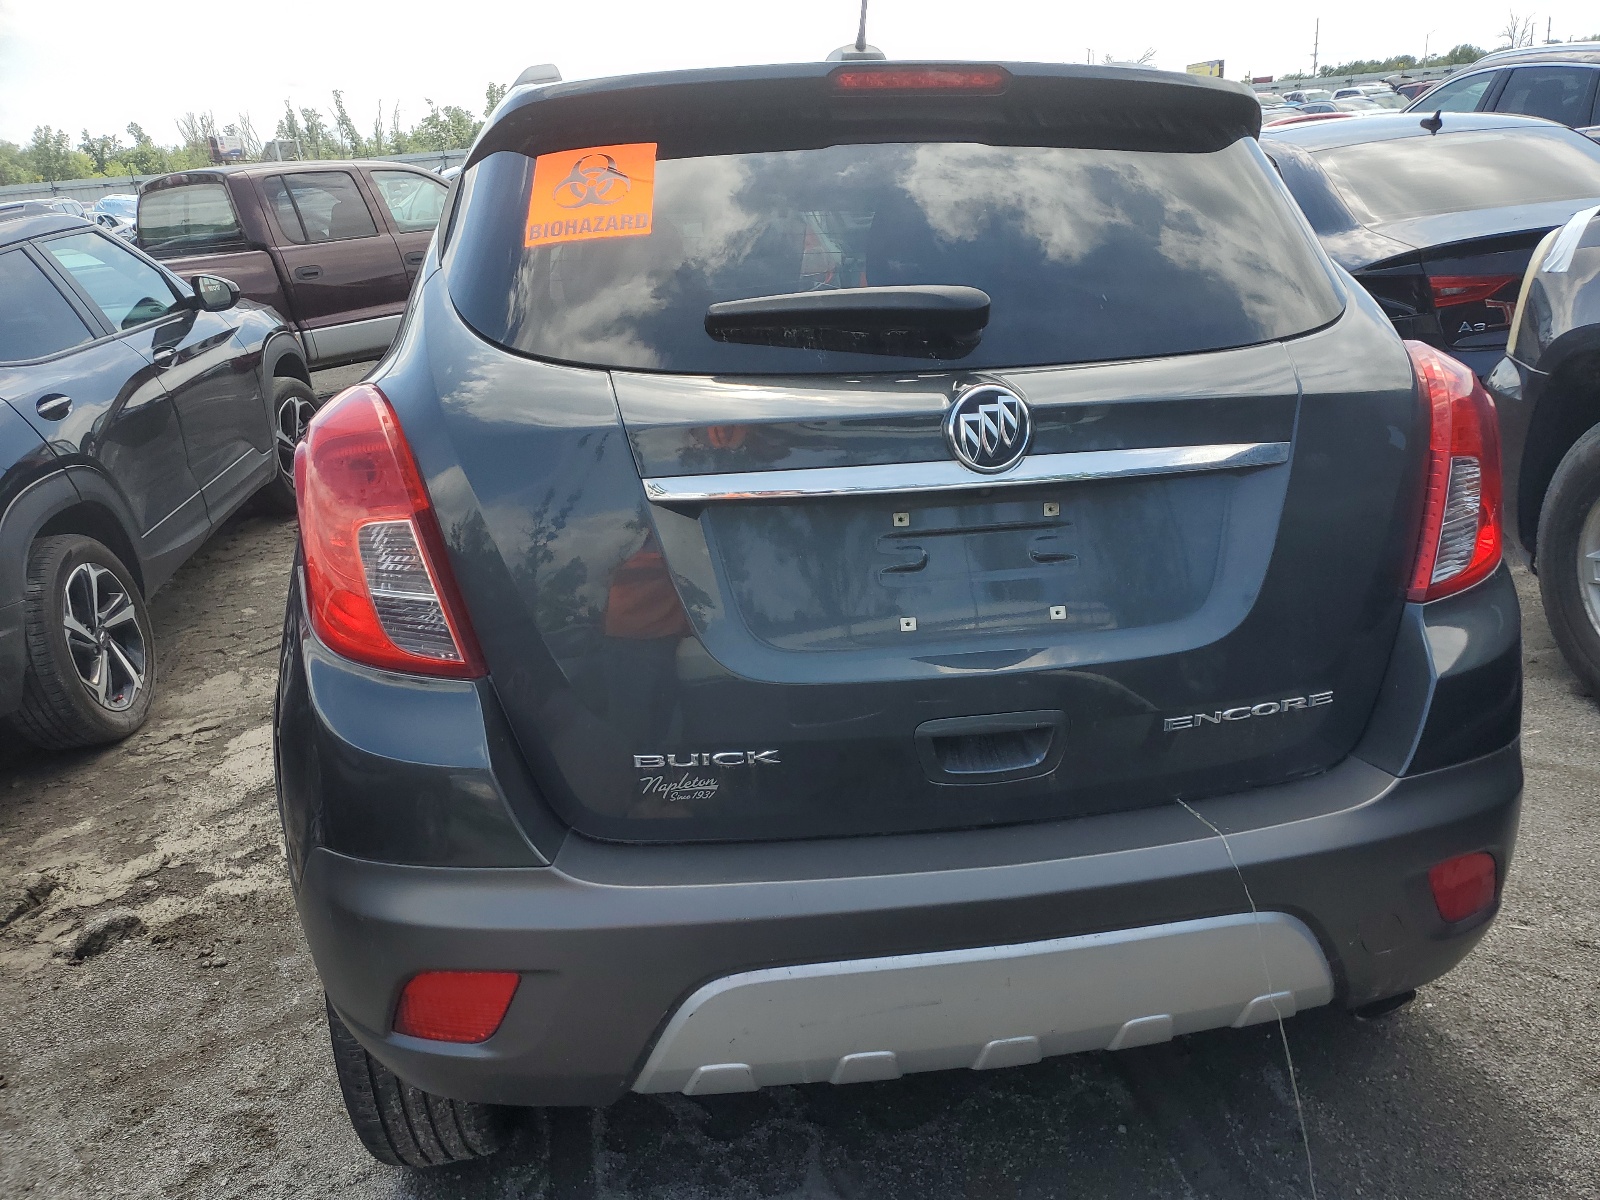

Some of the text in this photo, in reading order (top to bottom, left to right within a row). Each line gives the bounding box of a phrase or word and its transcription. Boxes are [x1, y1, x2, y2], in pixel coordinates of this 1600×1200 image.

[529, 213, 649, 240] BIOHAZARD
[1458, 321, 1486, 333] A3
[1163, 690, 1334, 732] ENCORE
[633, 750, 781, 768] BUICK
[640, 772, 717, 798] Napleton
[669, 790, 716, 802] Since 1931
